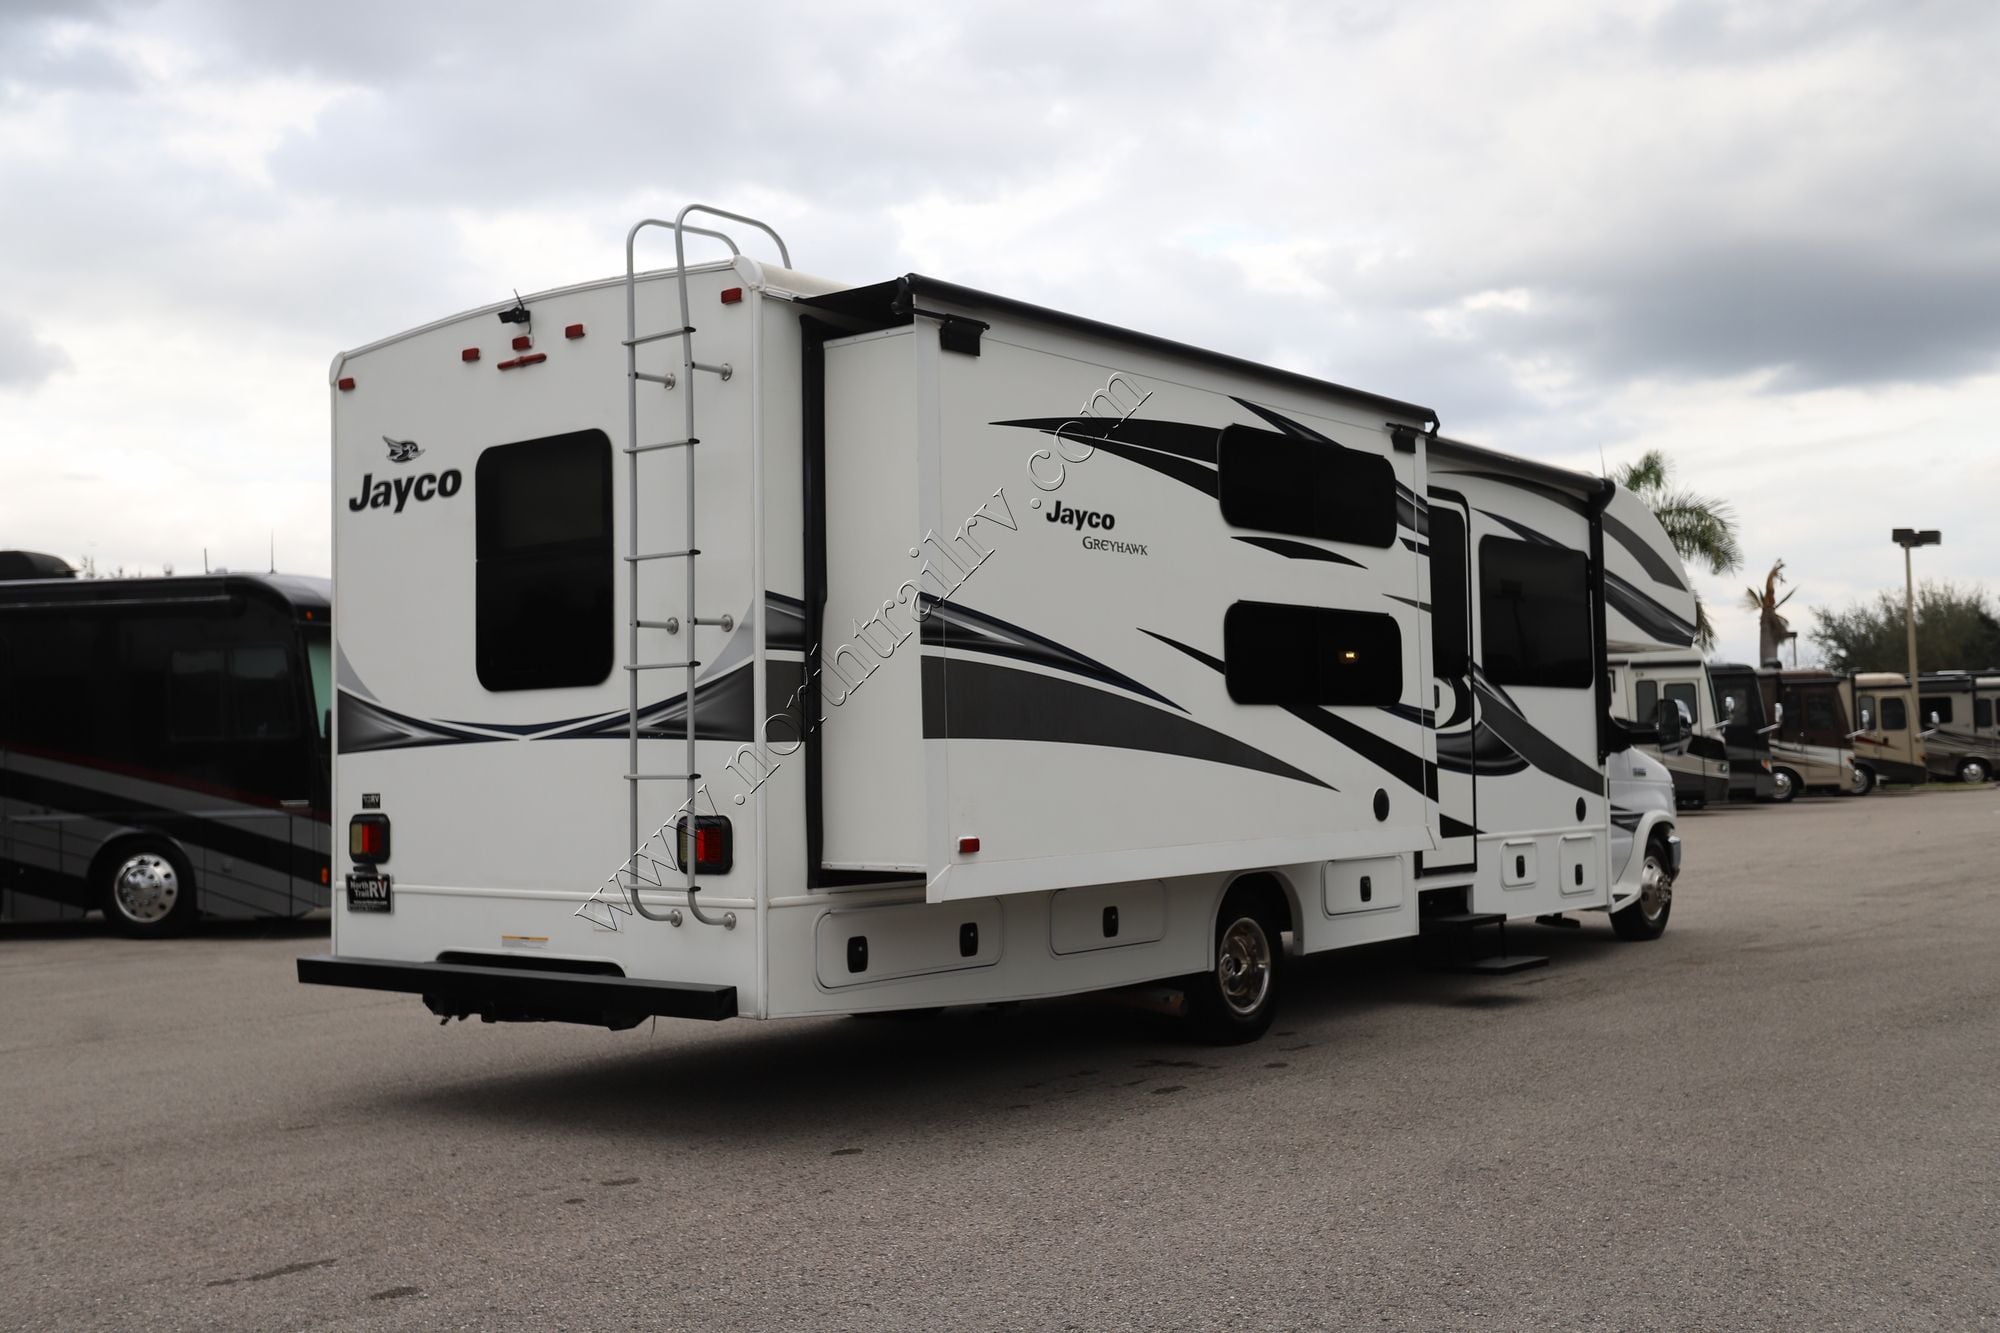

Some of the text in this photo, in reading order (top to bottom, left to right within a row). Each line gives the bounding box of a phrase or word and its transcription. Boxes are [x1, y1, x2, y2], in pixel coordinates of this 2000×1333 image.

[348, 468, 462, 515] Jayco
[1046, 500, 1115, 531] Jayco
[369, 880, 388, 898] RV
